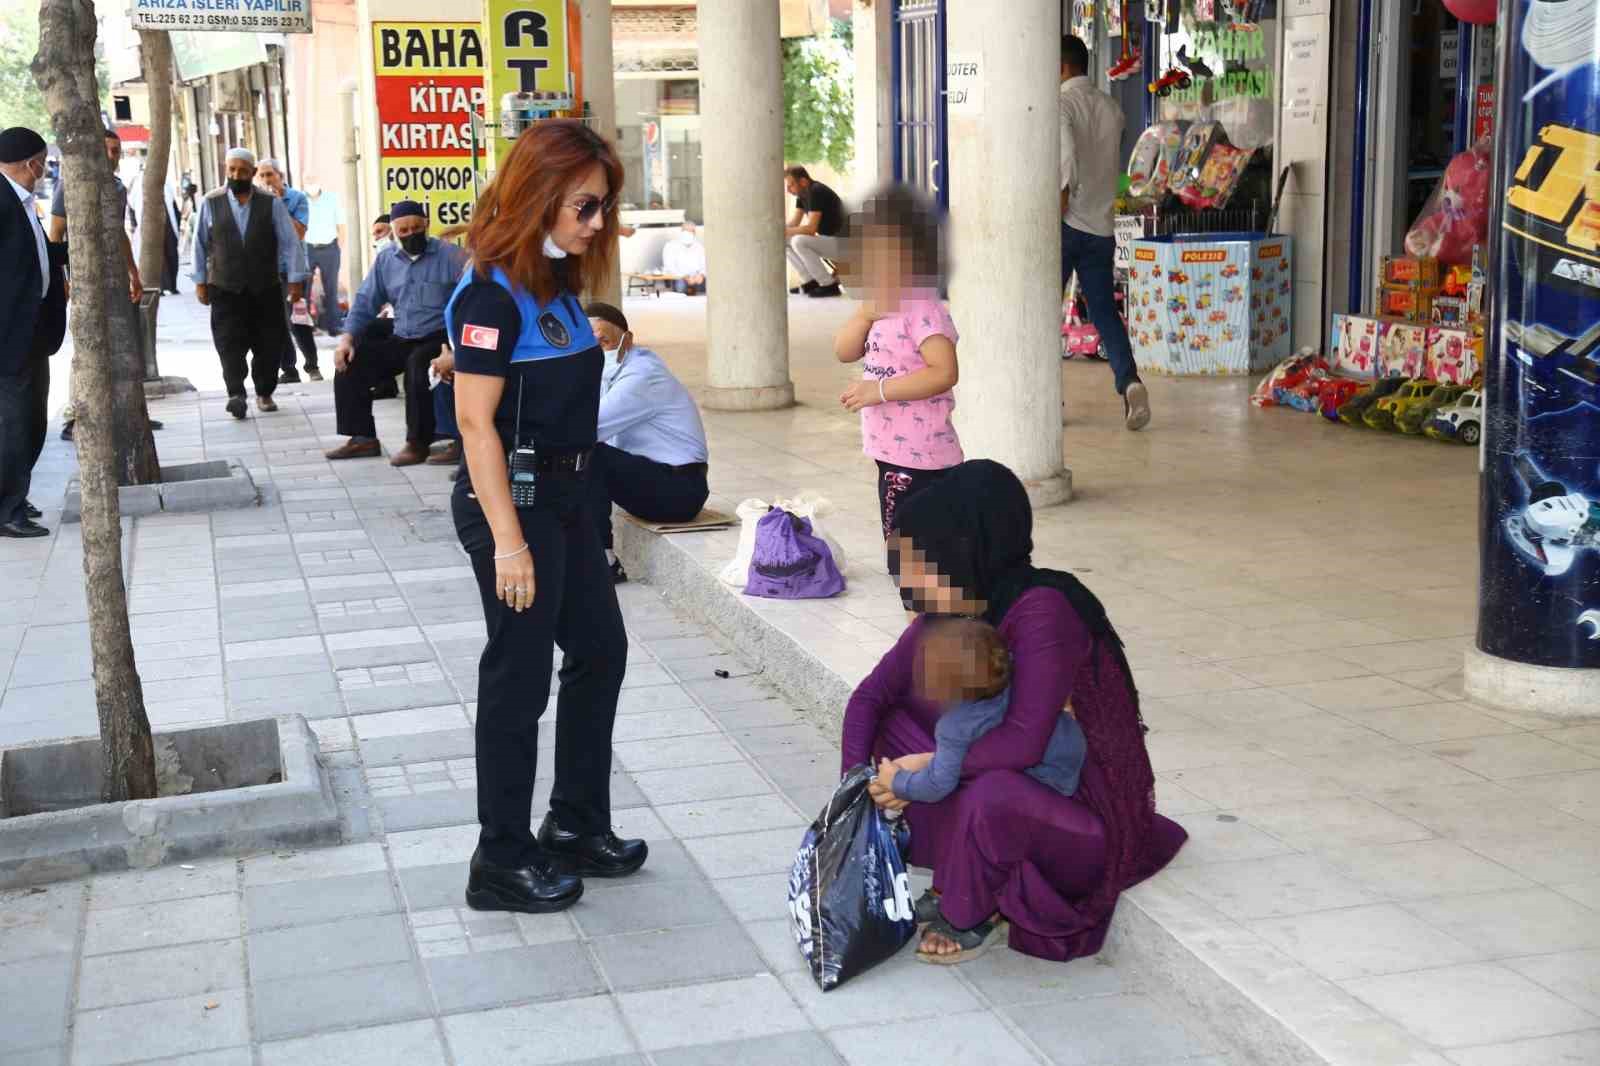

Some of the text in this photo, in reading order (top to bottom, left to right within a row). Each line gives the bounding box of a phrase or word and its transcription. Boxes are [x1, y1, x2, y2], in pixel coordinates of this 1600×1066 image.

[179, 14, 191, 24] 62
[193, 15, 205, 24] 23
[207, 15, 239, 25] GSM:0
[242, 16, 259, 26] 535
[261, 16, 279, 26] 295
[281, 17, 292, 26] 23
